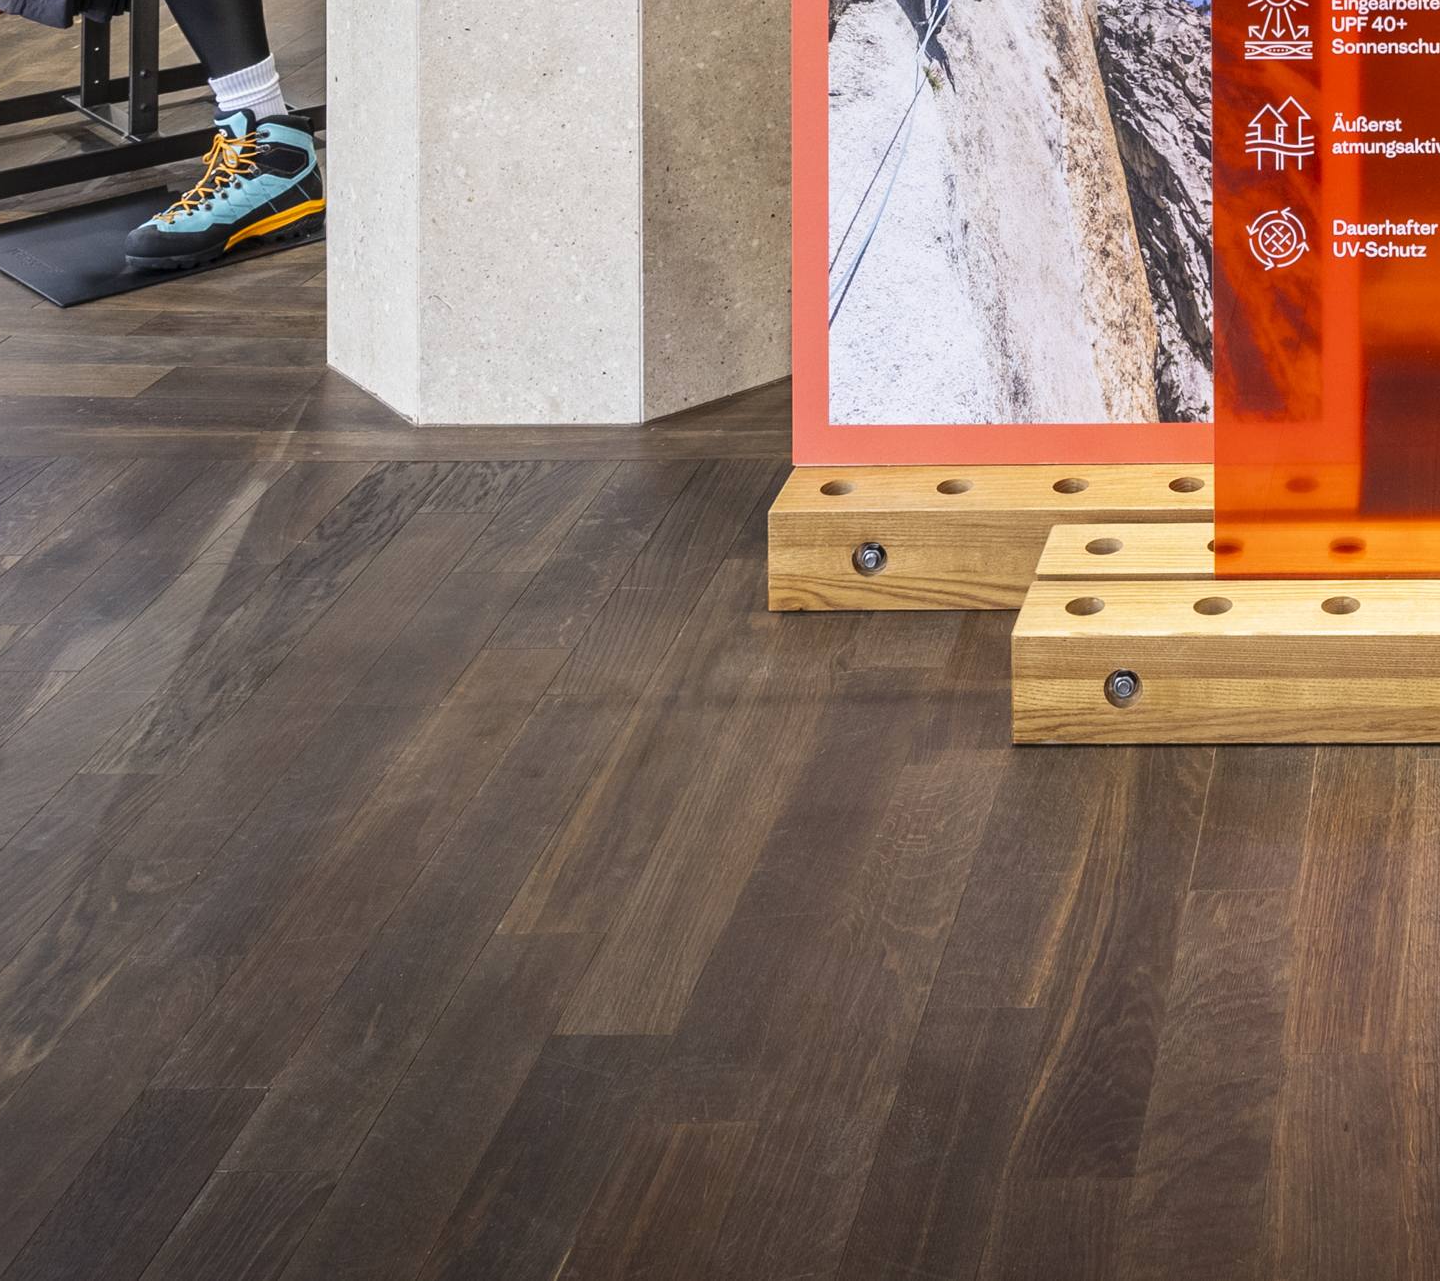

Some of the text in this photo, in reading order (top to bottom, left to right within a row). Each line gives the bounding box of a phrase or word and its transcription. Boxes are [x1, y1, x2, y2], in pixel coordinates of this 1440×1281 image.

[1332, 16, 1407, 32] UPF 40+
[1333, 113, 1402, 132] Äußerst
[1333, 219, 1438, 235] Dauerhafter
[1333, 241, 1426, 257] UV-Schutz
